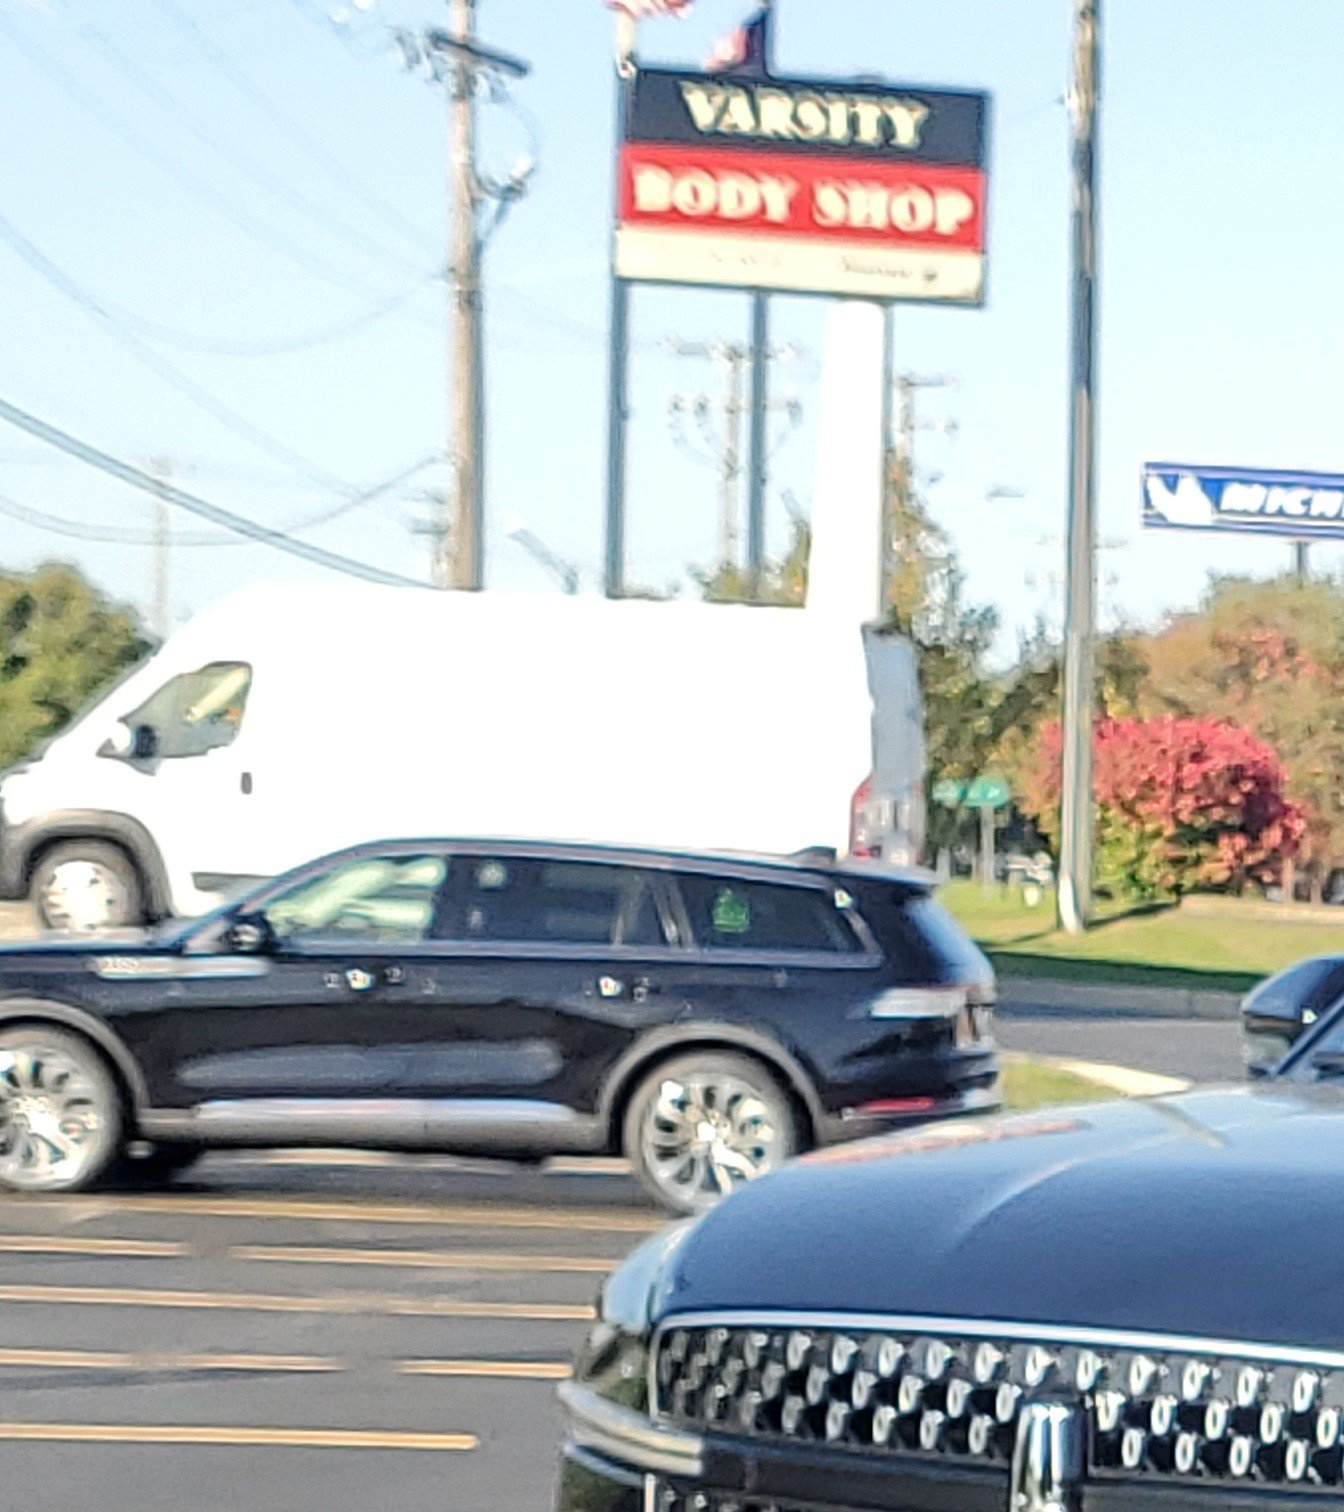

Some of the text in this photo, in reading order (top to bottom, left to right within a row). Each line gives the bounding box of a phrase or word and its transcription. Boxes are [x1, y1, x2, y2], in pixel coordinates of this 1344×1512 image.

[677, 79, 930, 150] VARSITY
[630, 162, 974, 236] BODY SHOP
